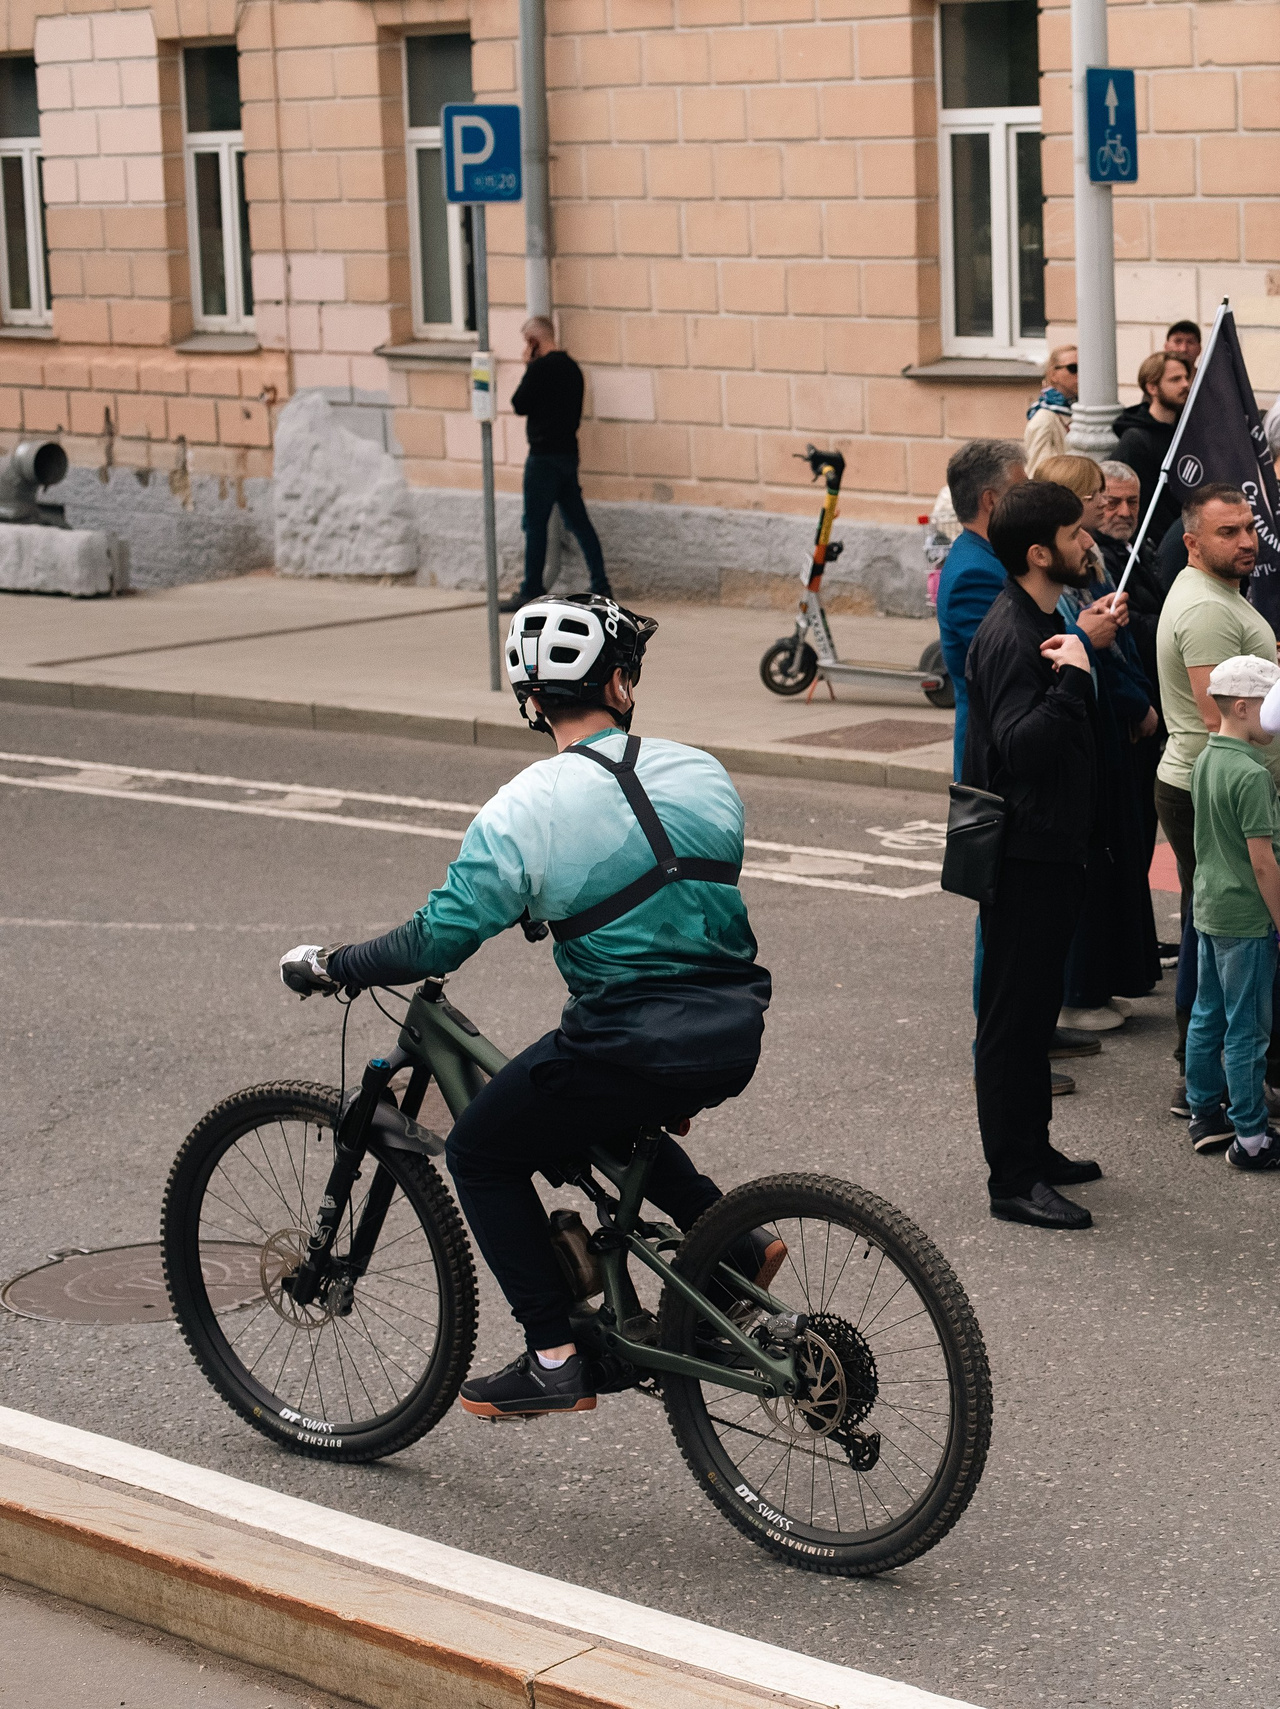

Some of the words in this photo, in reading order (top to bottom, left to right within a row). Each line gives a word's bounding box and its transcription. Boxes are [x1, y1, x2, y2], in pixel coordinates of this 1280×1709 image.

[452, 114, 494, 193] P
[279, 1407, 301, 1423] DT
[302, 1417, 335, 1435] SWISS
[296, 1431, 342, 1448] BUTCHER
[734, 1483, 759, 1504] DT
[754, 1502, 793, 1531] SWISS
[765, 1528, 836, 1557] ELIMINATOR
